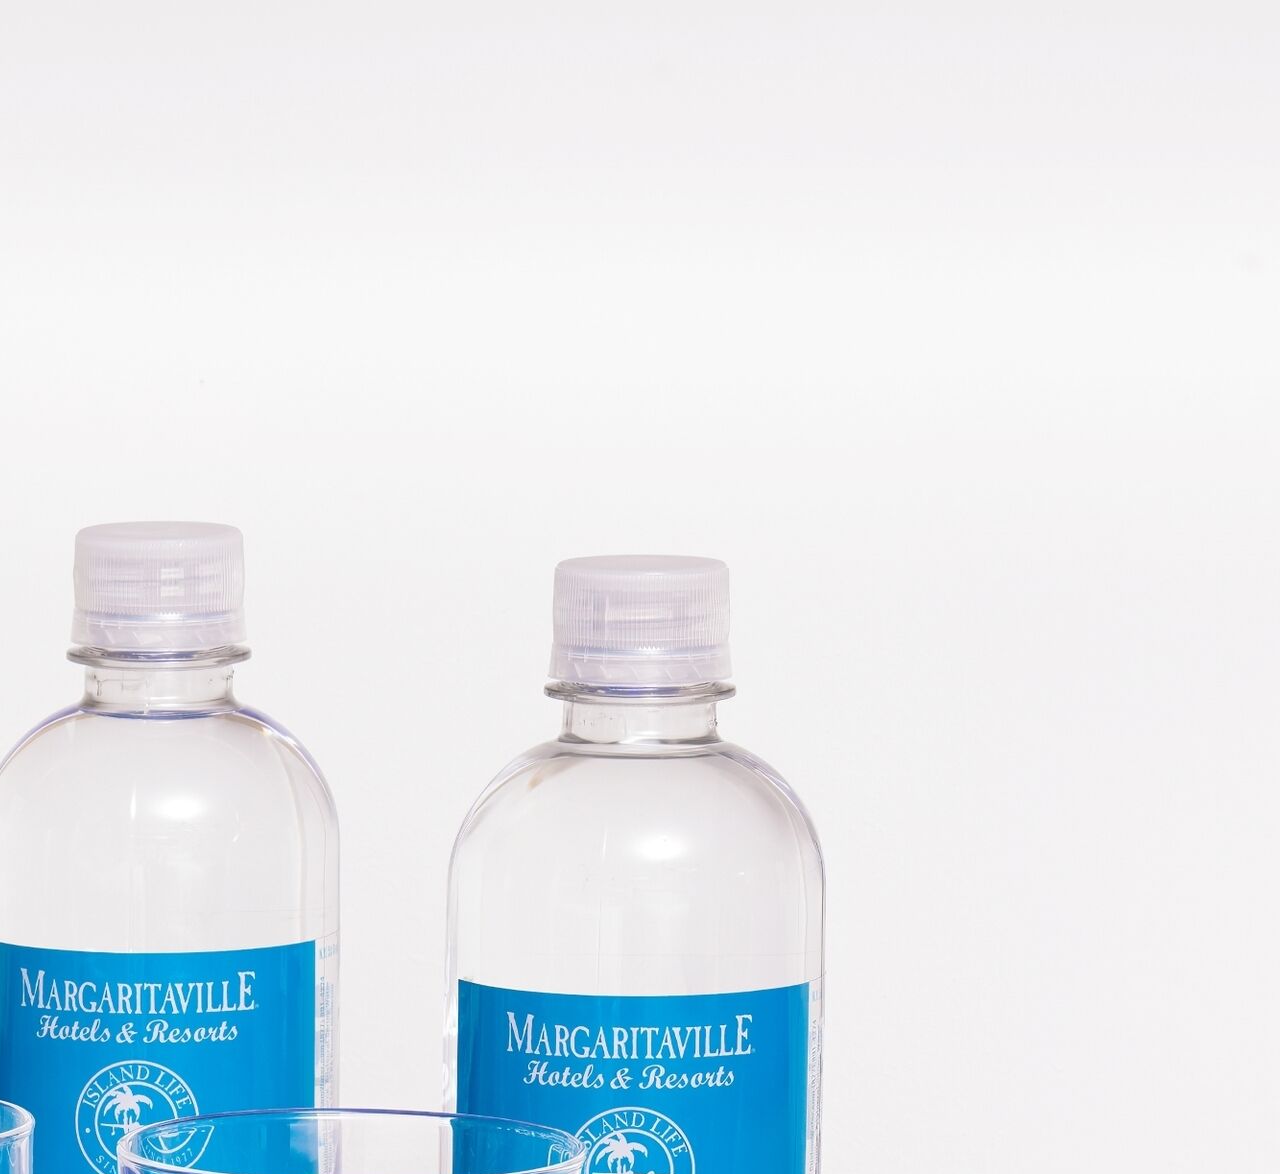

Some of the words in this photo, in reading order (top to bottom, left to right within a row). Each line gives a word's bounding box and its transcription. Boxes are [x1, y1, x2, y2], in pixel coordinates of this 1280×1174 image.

[21, 968, 256, 1015] MARGARITAVILLE
[37, 1014, 111, 1043] Hotels
[116, 1022, 138, 1044] &
[143, 1019, 238, 1044] Resorts
[507, 1011, 753, 1060] MARGARITAVILLE
[82, 1065, 150, 1109] ISLAND
[155, 1070, 193, 1110] LIFE
[523, 1060, 605, 1089] Hotels
[610, 1067, 633, 1090] &
[639, 1064, 735, 1090] Resorts
[578, 1111, 645, 1149] SLAND
[649, 1117, 689, 1158] LIFE
